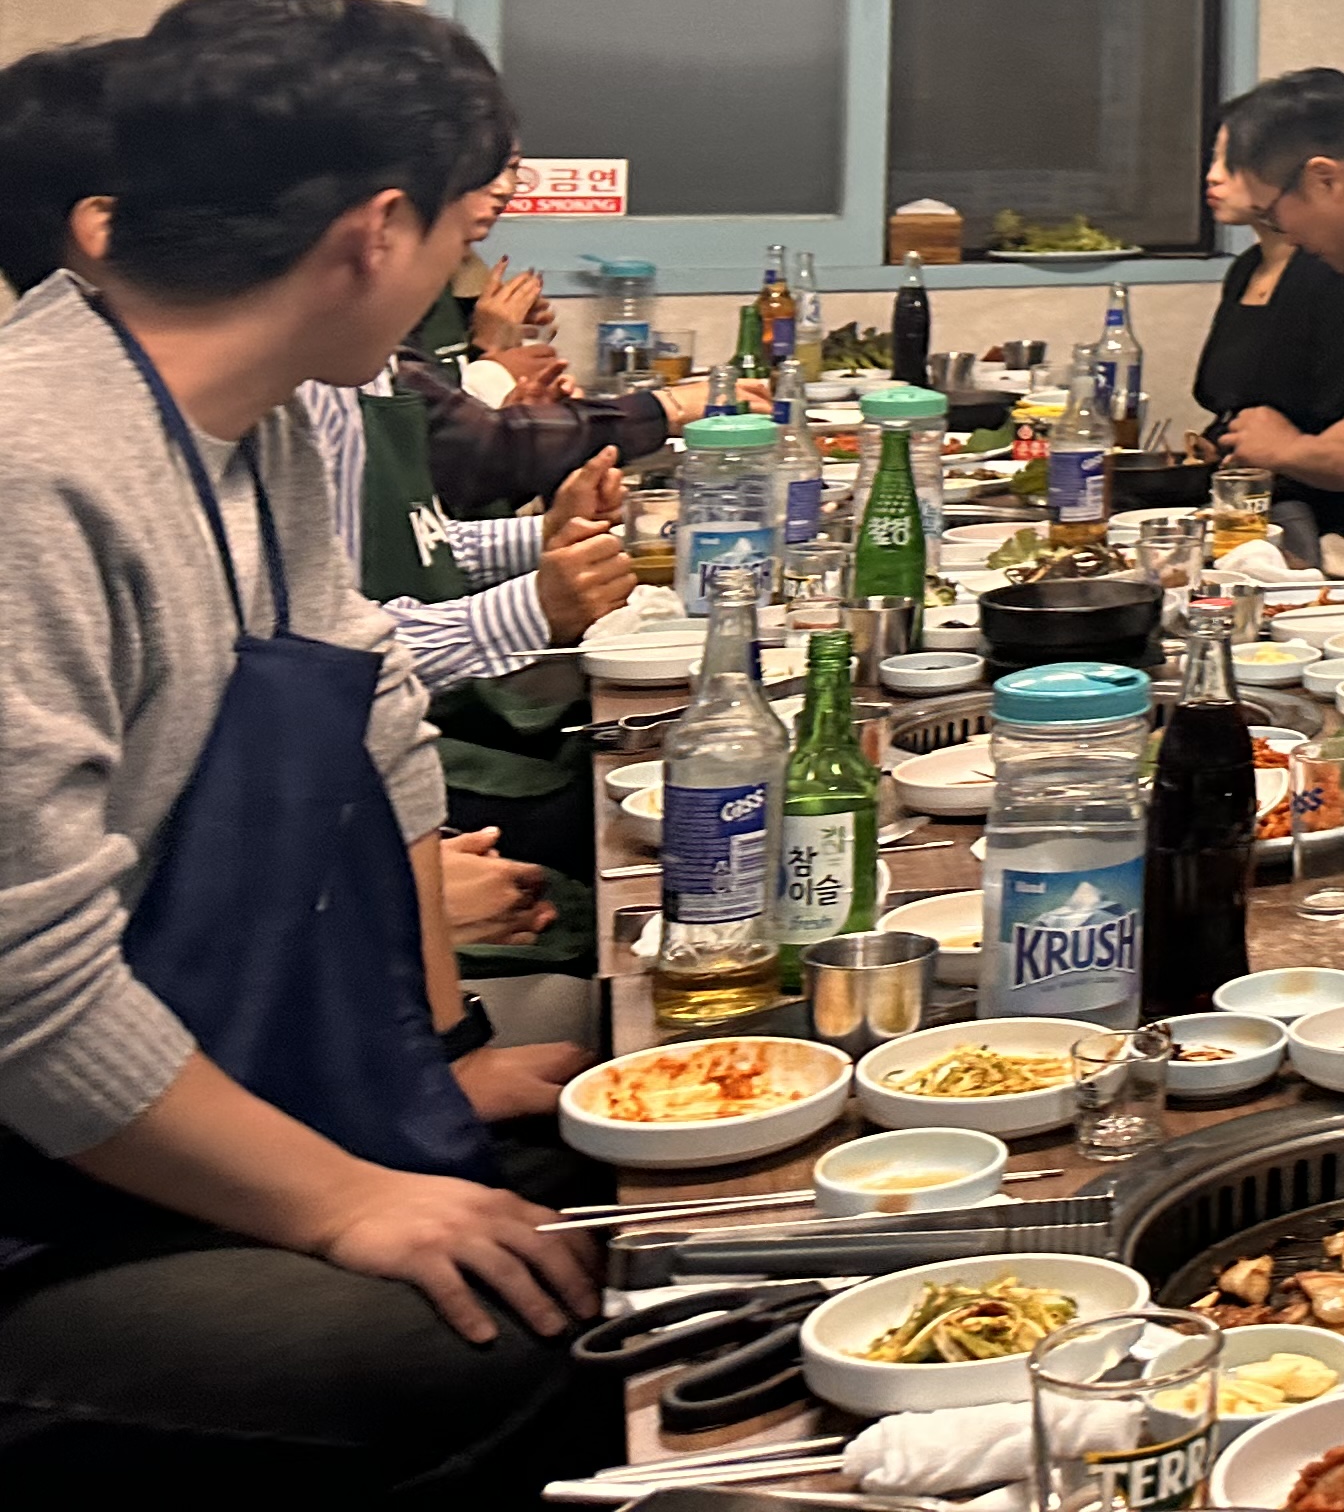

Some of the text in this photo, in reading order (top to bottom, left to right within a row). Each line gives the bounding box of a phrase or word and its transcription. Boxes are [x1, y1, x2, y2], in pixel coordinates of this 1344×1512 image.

[545, 168, 618, 192] 금연
[536, 199, 617, 212] SMOKING
[1015, 910, 1136, 986] KRUSH
[1086, 1426, 1219, 1511] TERR
